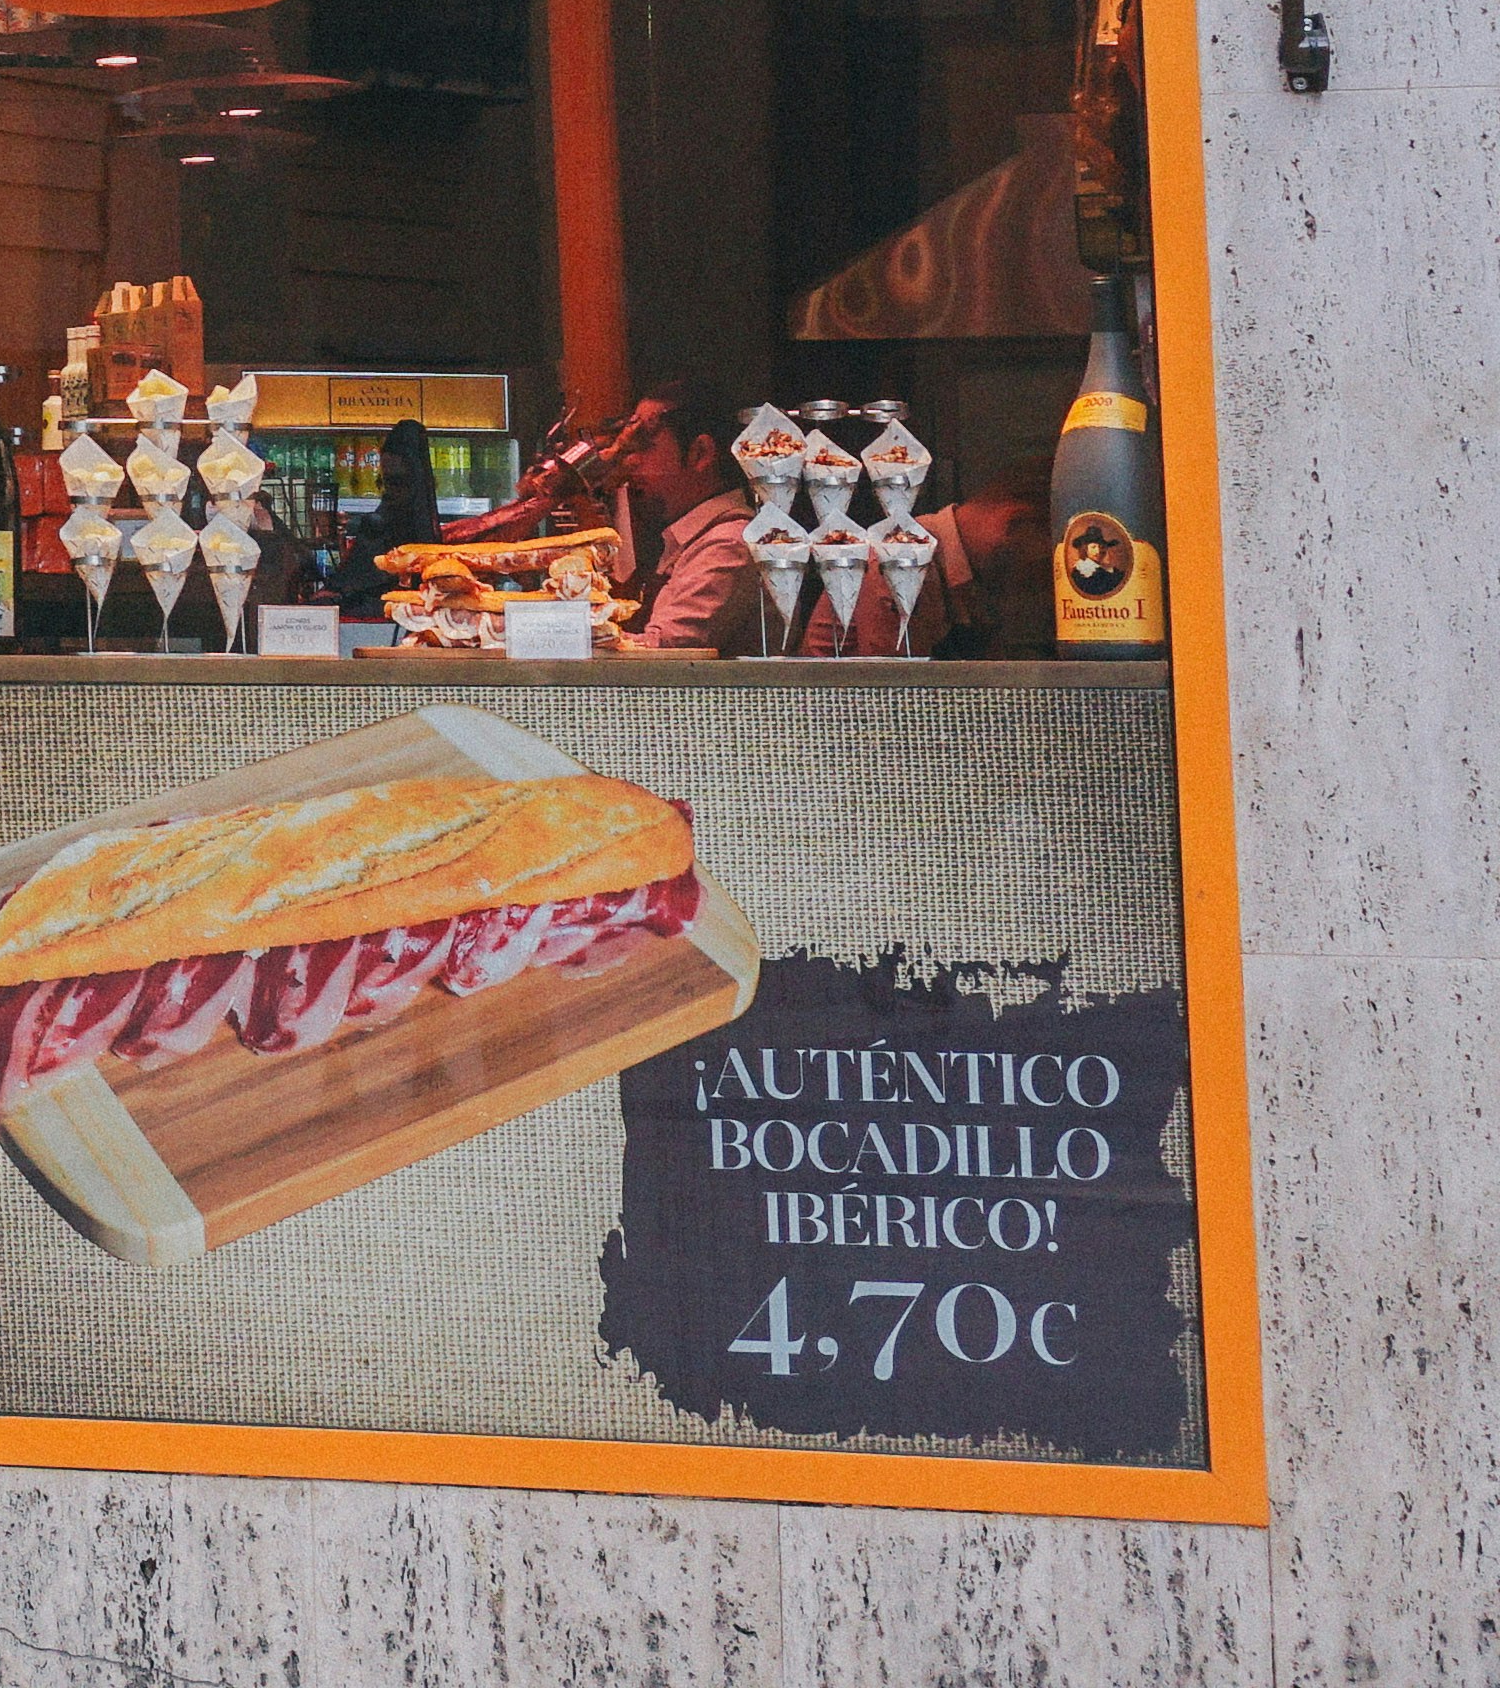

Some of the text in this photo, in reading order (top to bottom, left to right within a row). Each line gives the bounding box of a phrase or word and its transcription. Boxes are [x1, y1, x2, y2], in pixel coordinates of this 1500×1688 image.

[1062, 598, 1131, 621] Faustino
[694, 1038, 1121, 1112] ¡AUTÉNTICO
[706, 1117, 1111, 1181] BOCADILLO
[762, 1181, 1059, 1252] IBÉRICO!
